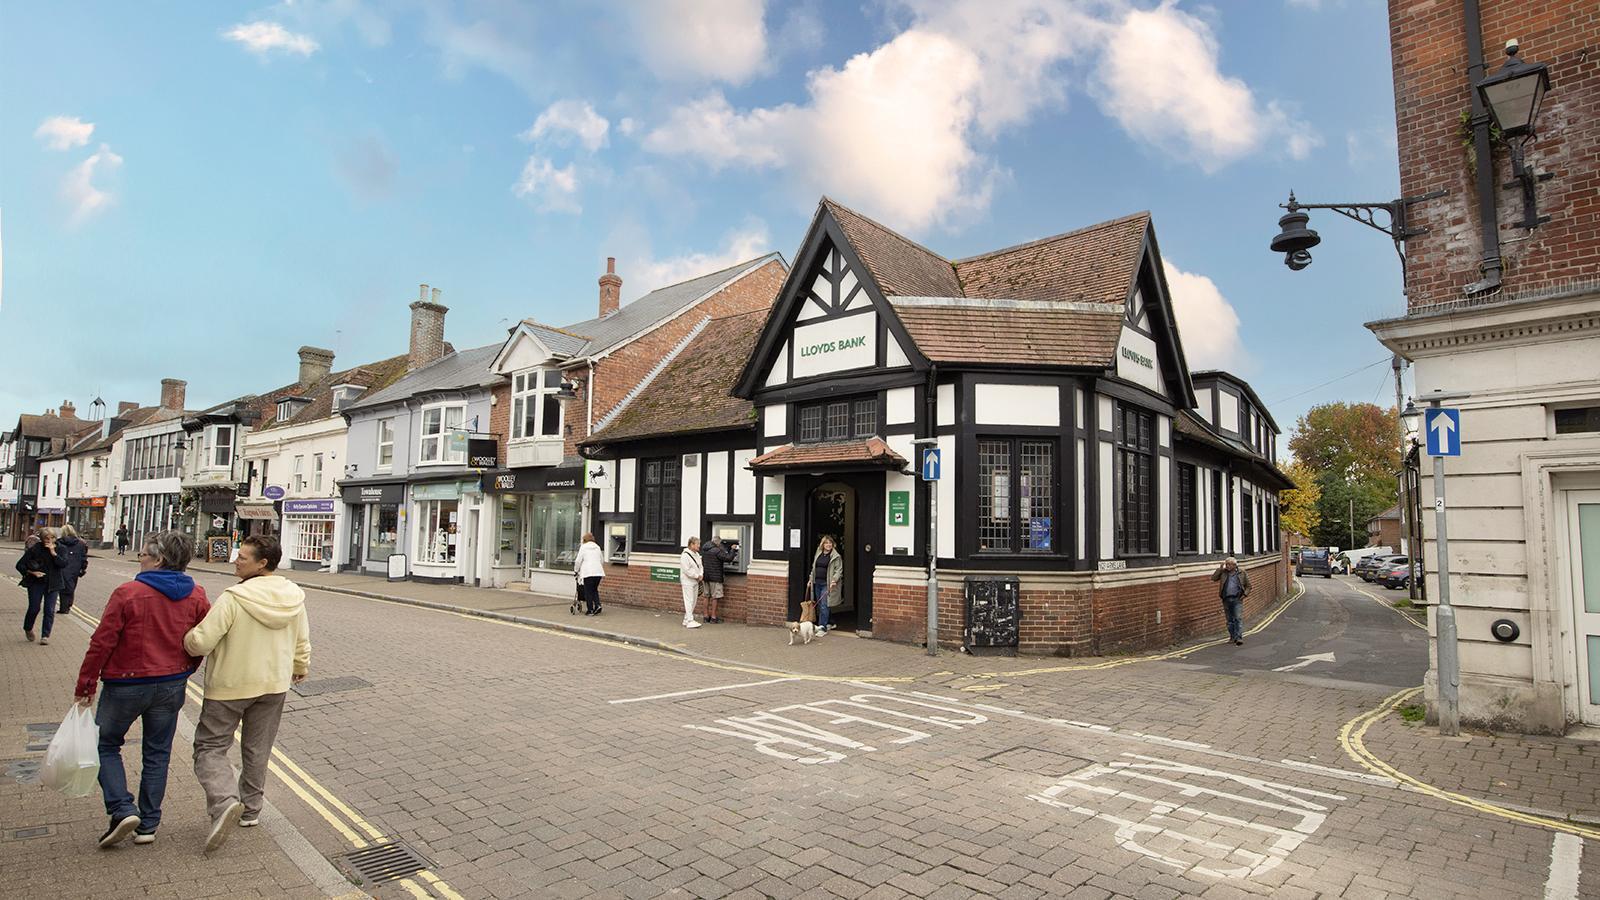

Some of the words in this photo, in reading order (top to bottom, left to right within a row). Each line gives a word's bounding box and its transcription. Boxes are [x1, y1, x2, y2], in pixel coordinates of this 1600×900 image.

[800, 342, 836, 357] LLOYDS
[838, 335, 866, 350] BANK
[1025, 752, 1348, 879] KEEP
